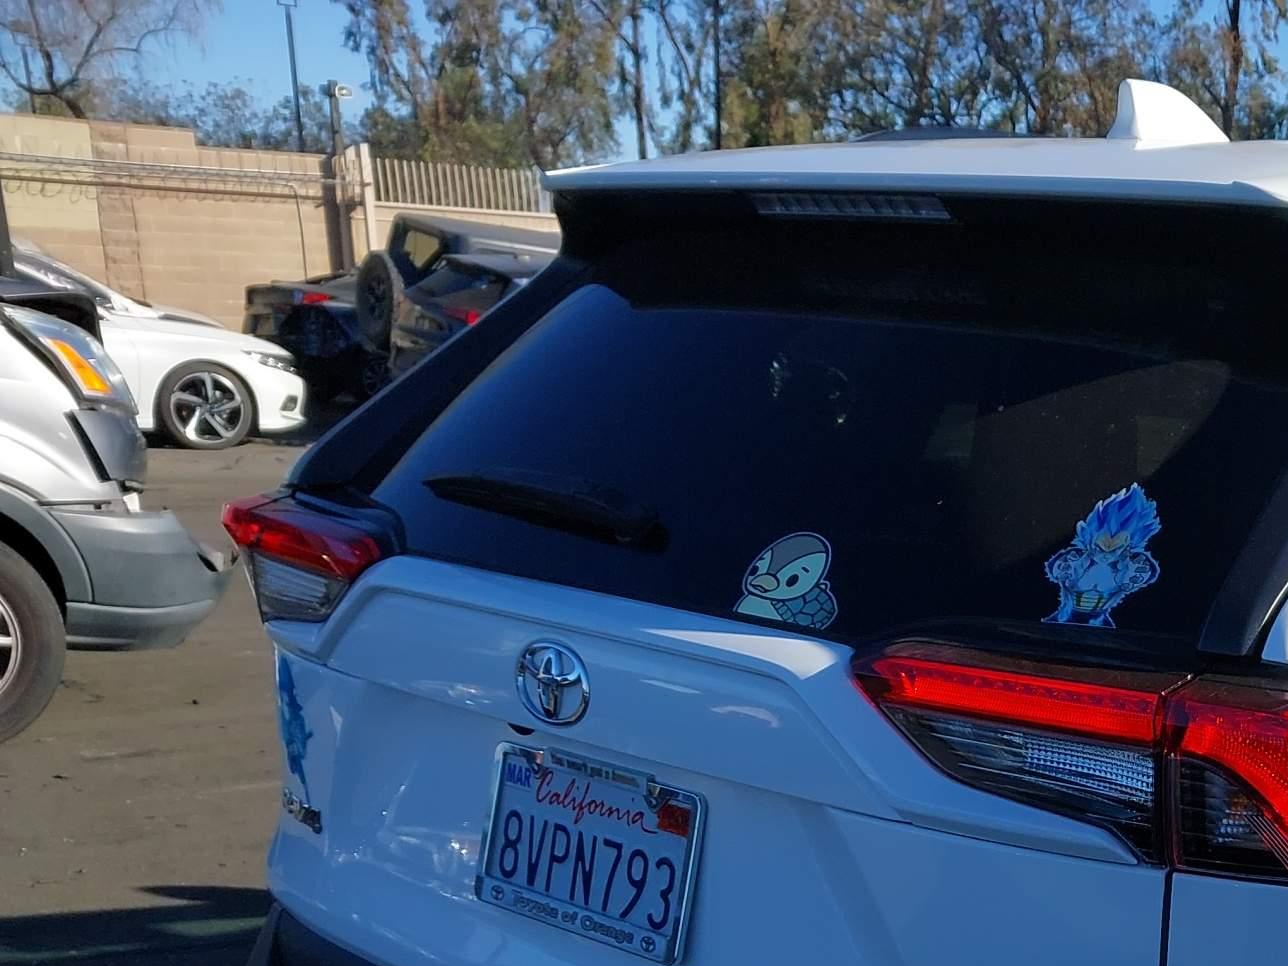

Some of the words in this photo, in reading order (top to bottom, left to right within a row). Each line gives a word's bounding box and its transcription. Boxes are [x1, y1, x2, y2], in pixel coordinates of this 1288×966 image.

[504, 762, 532, 788] MAR
[535, 767, 658, 834] California
[499, 809, 676, 930] 8VPN793
[512, 889, 559, 919] Toyota
[561, 910, 578, 926] of
[580, 915, 634, 944] Orange
